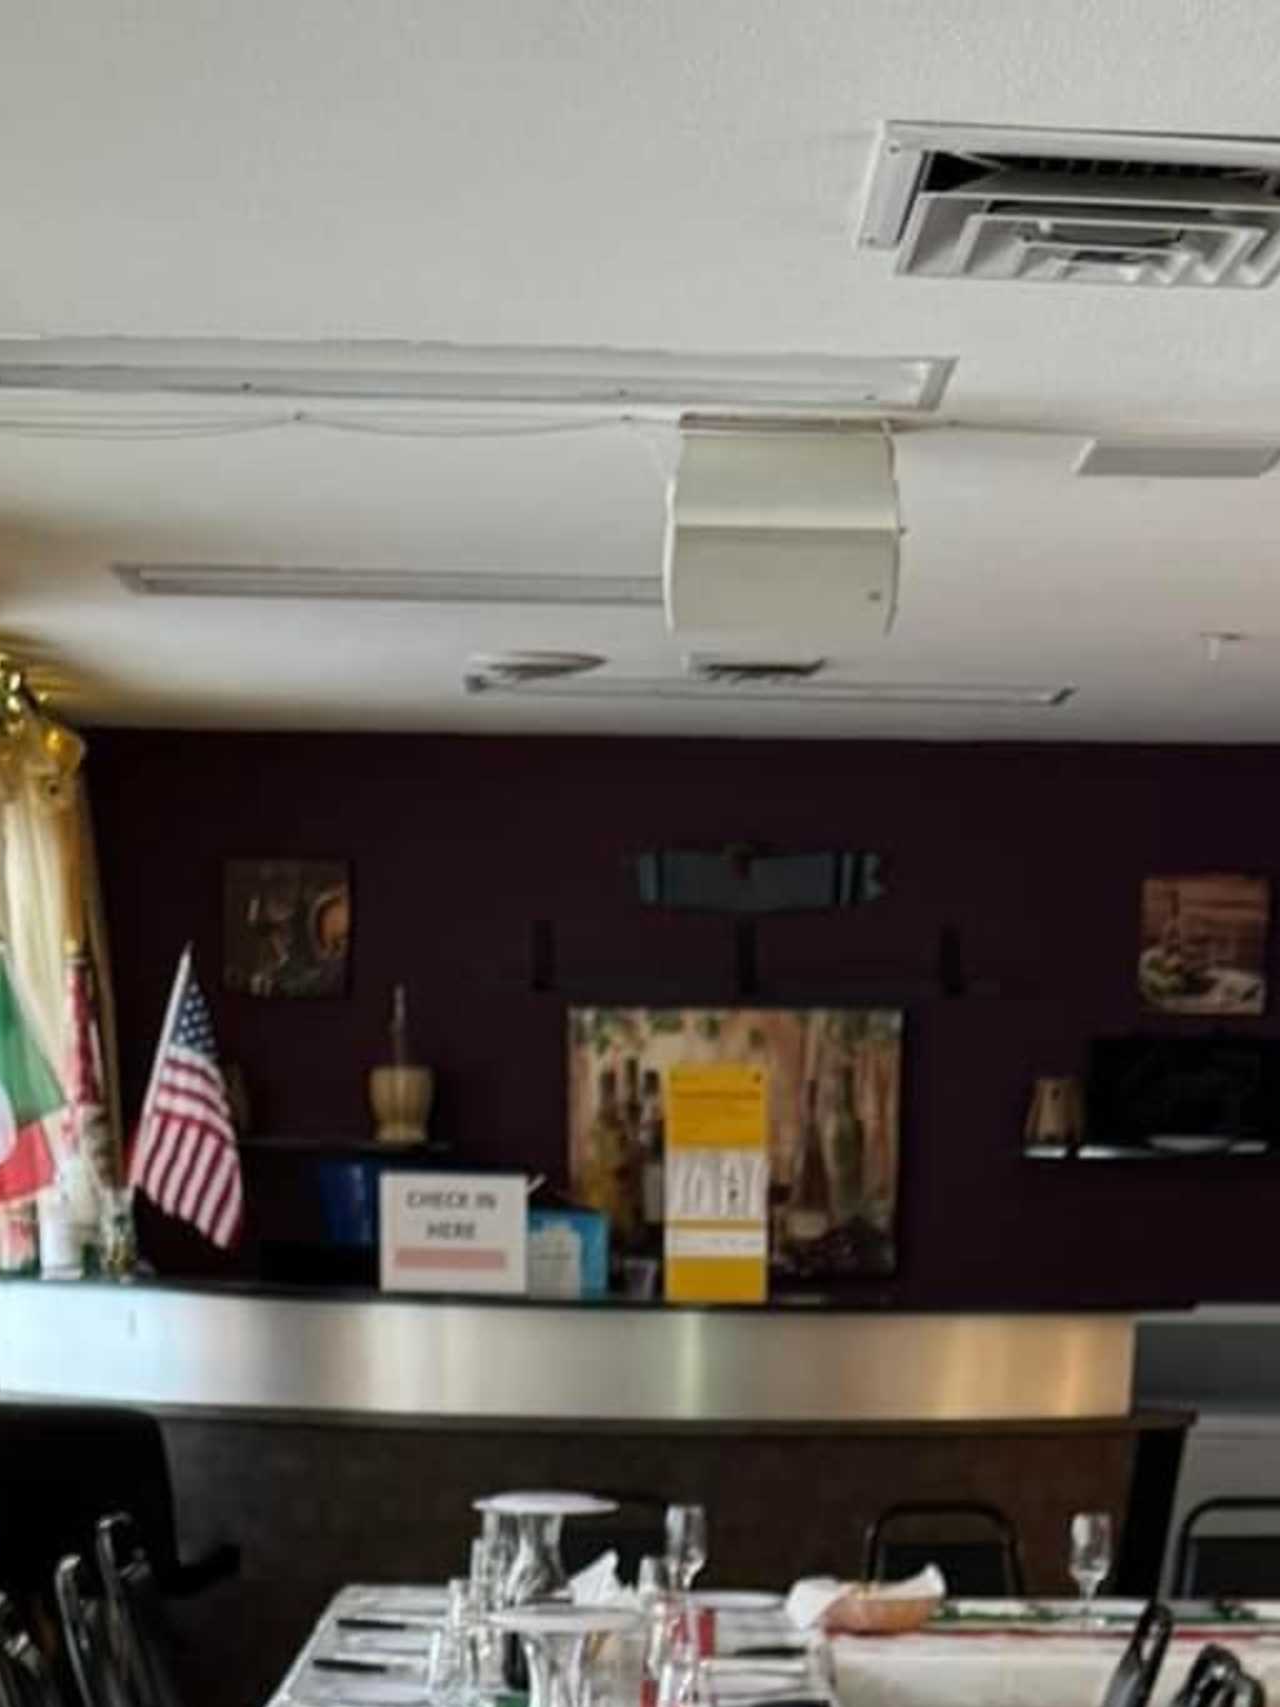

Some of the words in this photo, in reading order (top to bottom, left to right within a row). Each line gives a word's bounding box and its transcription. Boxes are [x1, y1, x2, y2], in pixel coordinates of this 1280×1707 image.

[405, 1191, 469, 1209] CHECK
[476, 1193, 497, 1209] IN
[426, 1222, 476, 1239] HERE
